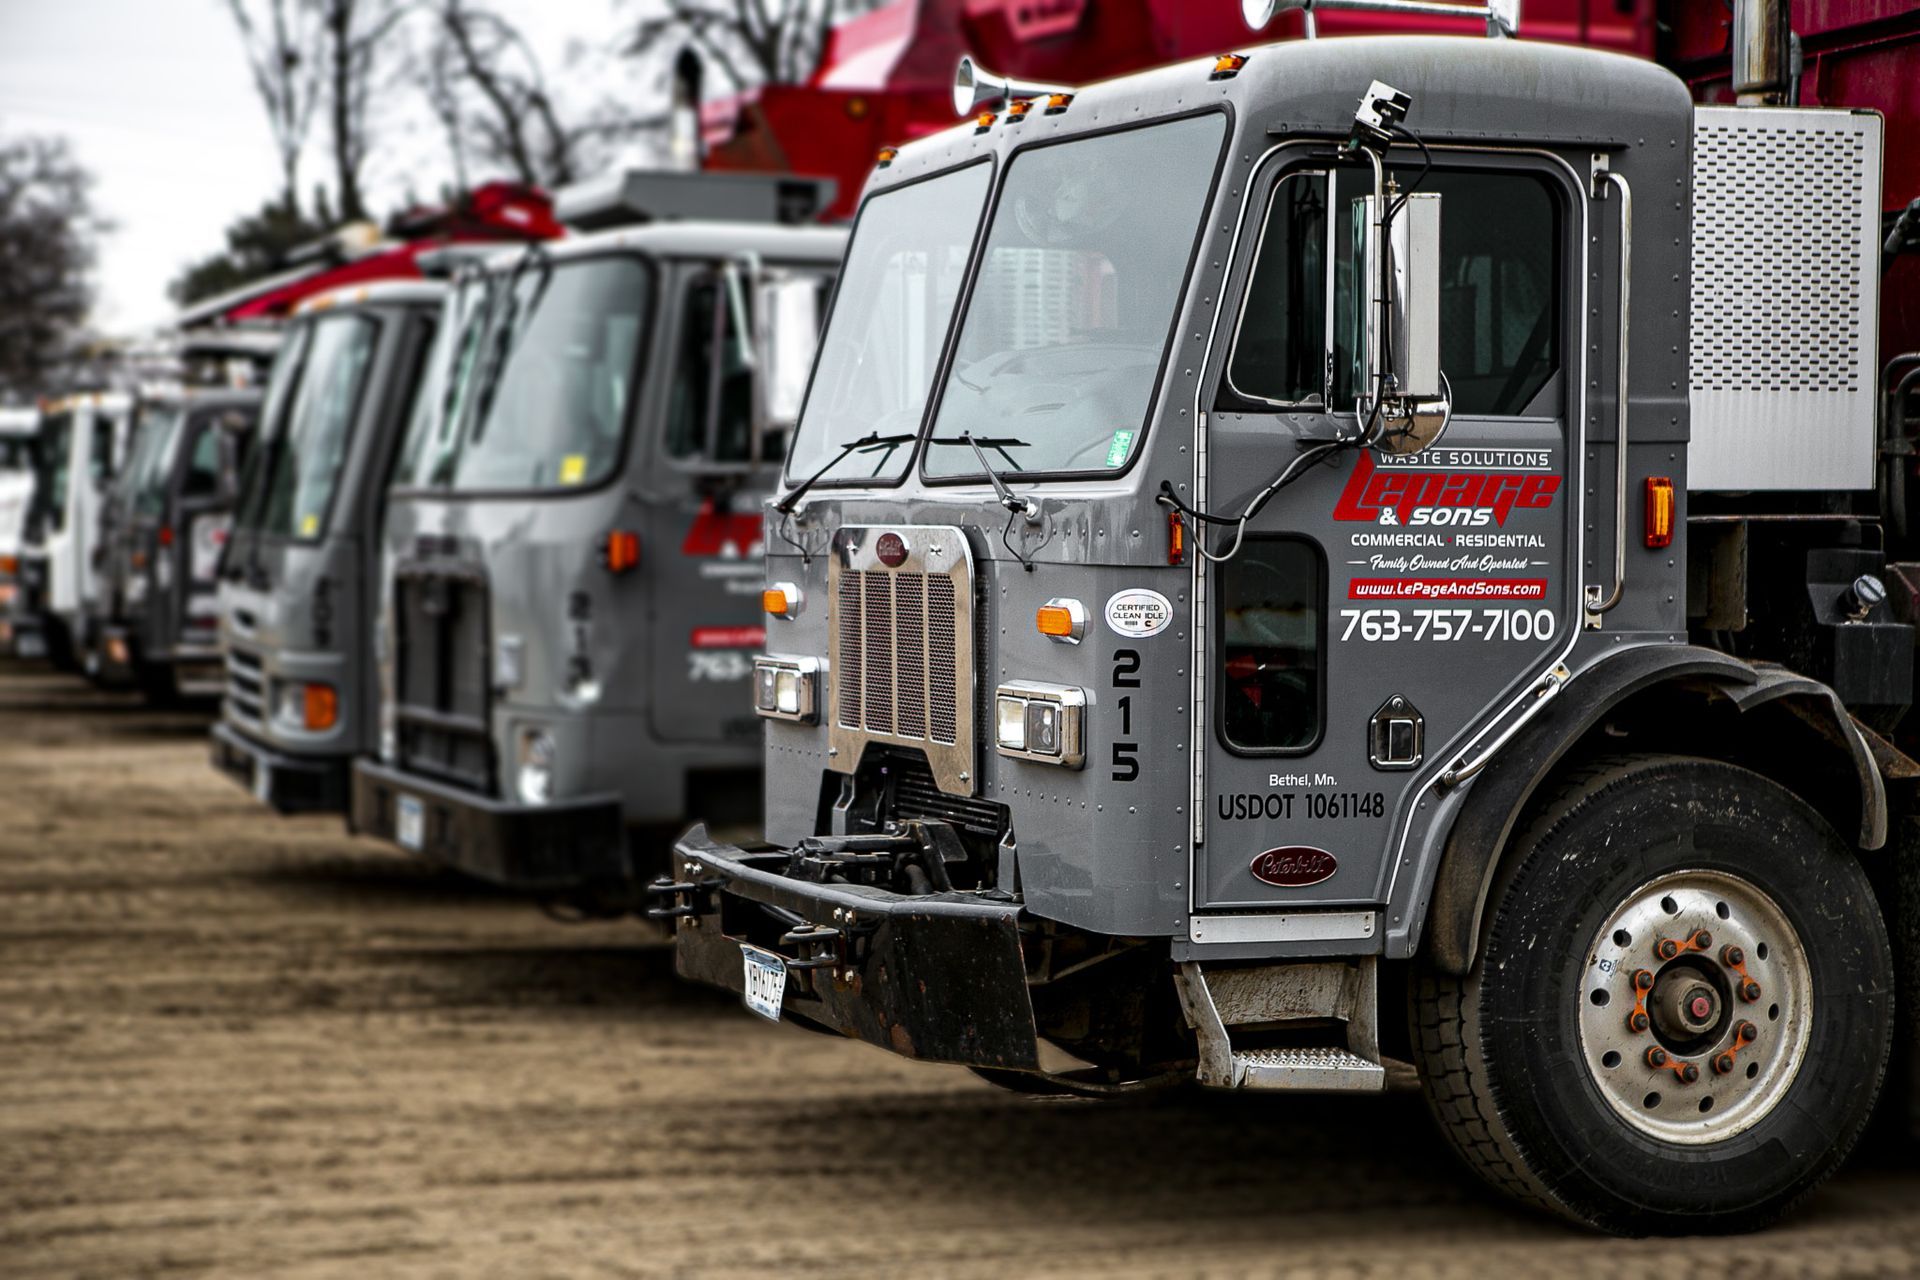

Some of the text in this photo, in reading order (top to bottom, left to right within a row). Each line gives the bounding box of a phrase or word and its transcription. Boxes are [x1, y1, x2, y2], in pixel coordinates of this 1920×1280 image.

[1449, 452, 1549, 467] SOLUTIONS
[1379, 507, 1399, 526] &
[1351, 533, 1546, 548] COMMERCIAL RESIDENTIAL
[1370, 553, 1528, 572] Family Owned And Operated
[1356, 581, 1541, 597] www.LePageAndSons.com
[1144, 612, 1164, 620] IDLE
[1340, 608, 1555, 642] 763-757-7100
[1112, 649, 1141, 782] 215
[1269, 774, 1338, 787] Bethel, Mn.
[1218, 792, 1385, 820] USDOT 1061148
[1261, 853, 1330, 876] Peterbilt
